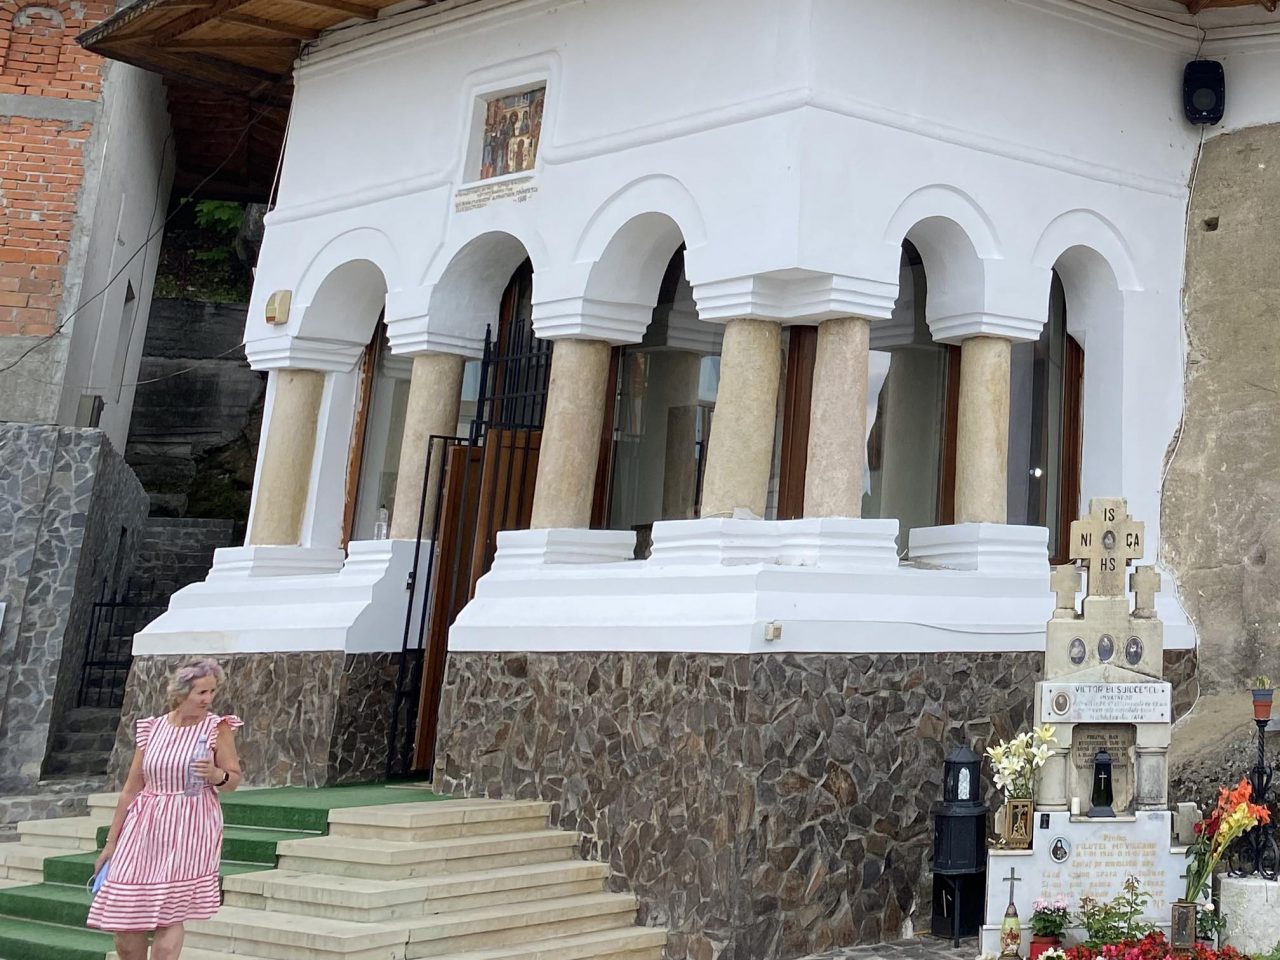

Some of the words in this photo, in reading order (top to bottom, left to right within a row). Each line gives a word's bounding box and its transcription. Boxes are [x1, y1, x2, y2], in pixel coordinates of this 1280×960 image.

[1104, 507, 1115, 521] IS
[1080, 532, 1092, 547] NI
[1100, 557, 1116, 571] HS
